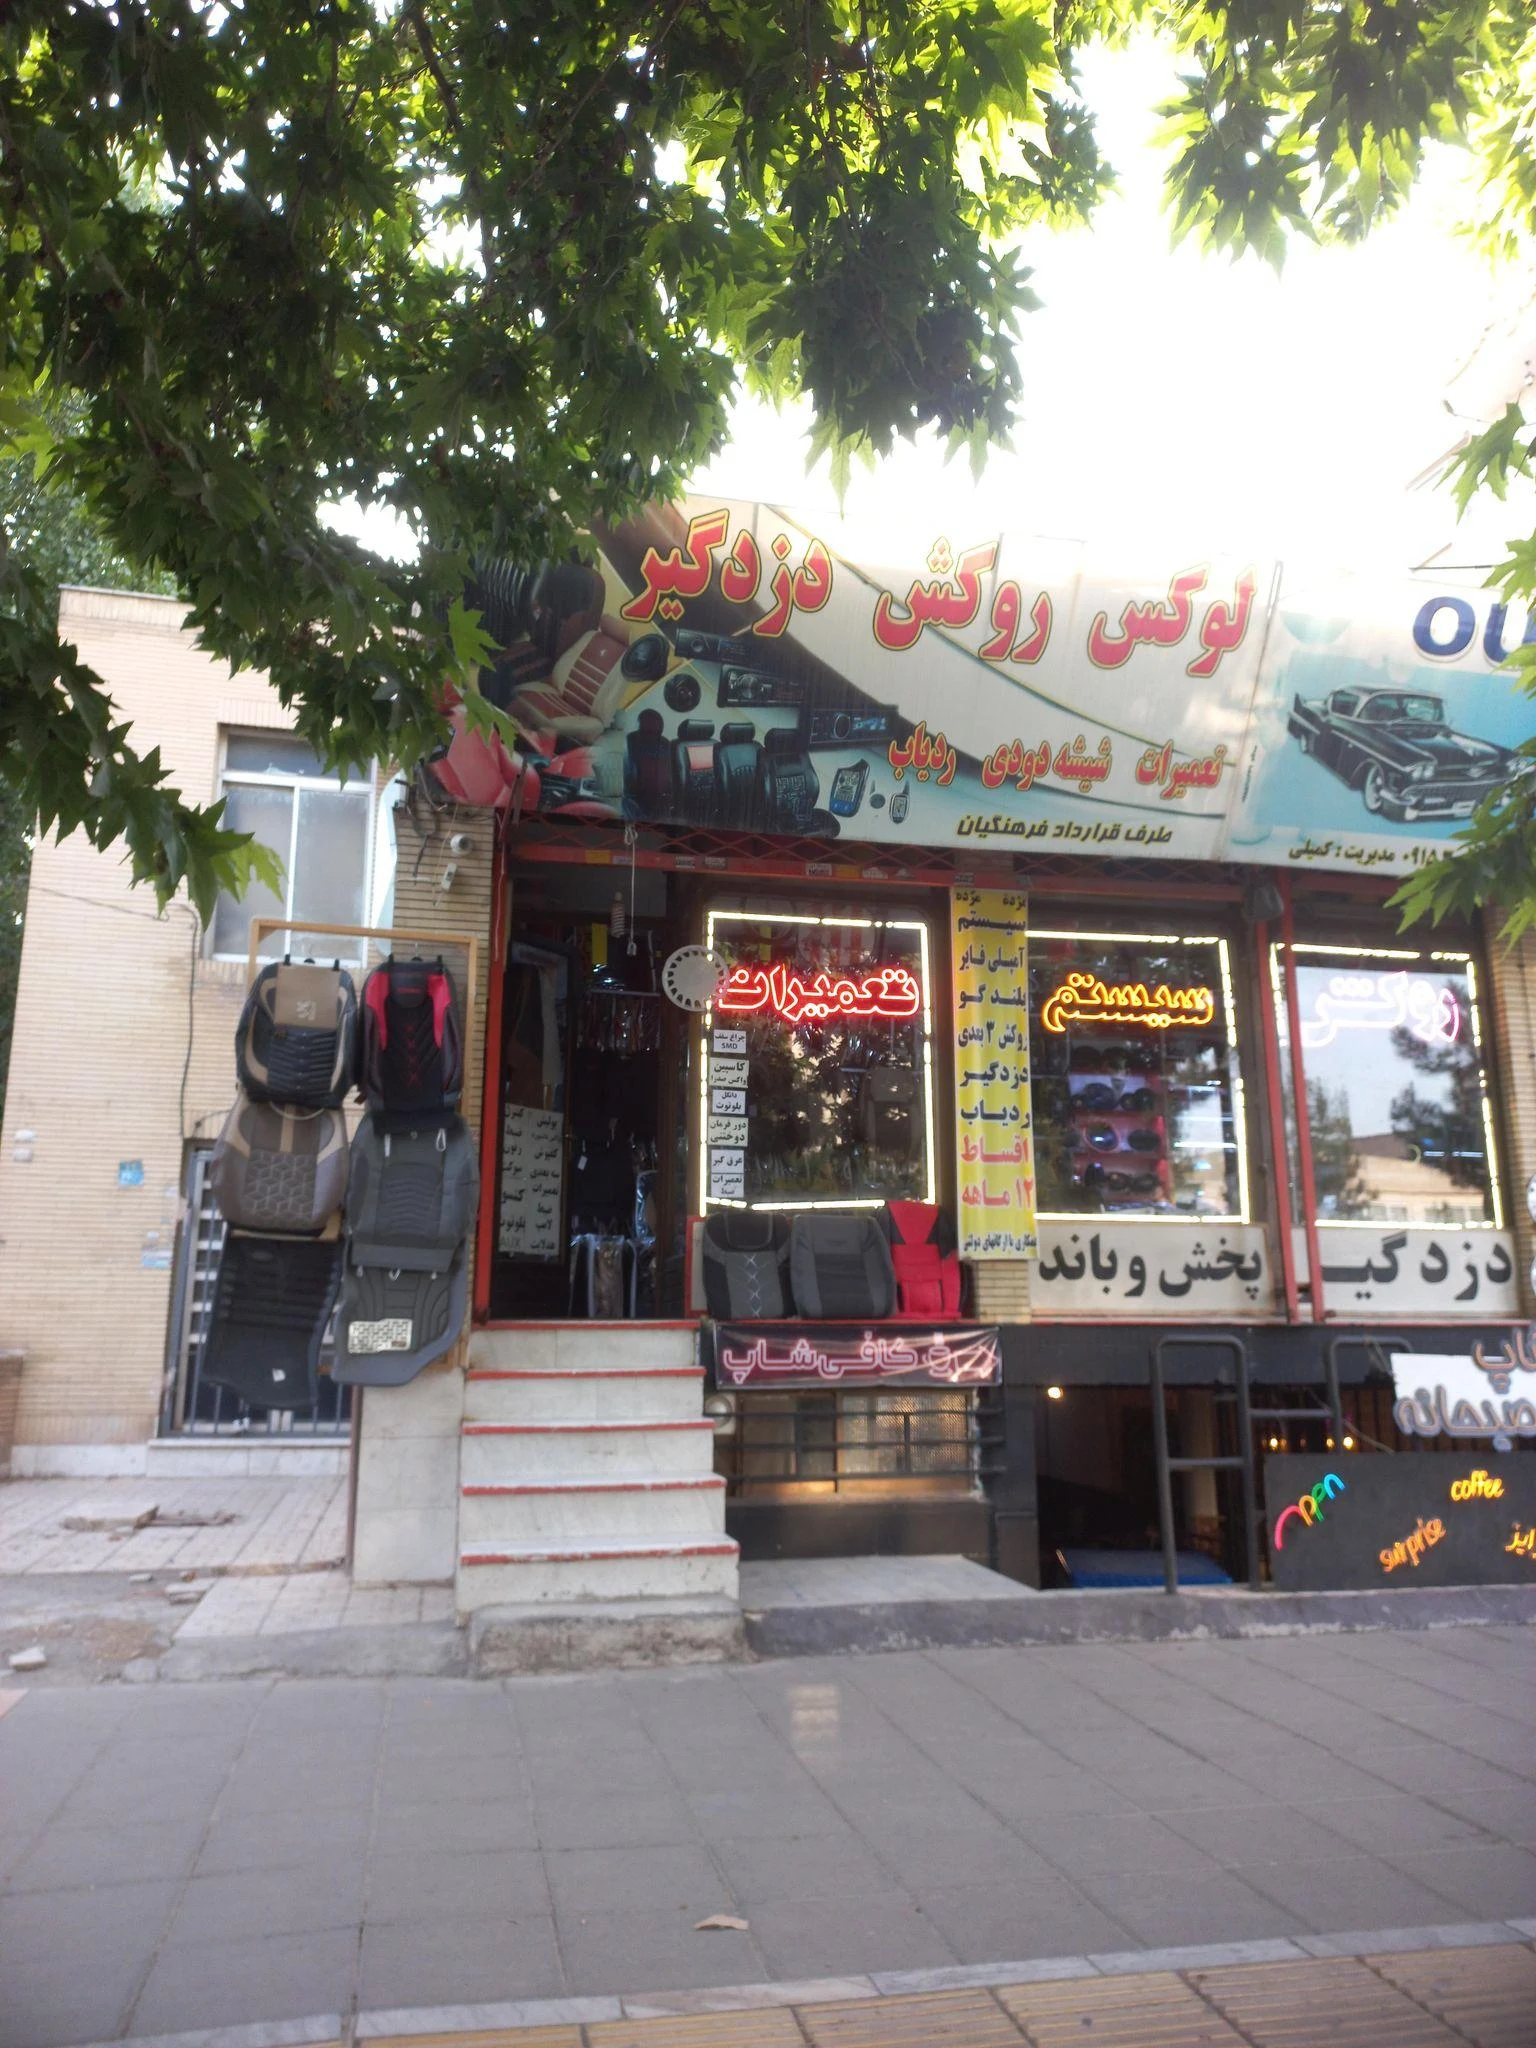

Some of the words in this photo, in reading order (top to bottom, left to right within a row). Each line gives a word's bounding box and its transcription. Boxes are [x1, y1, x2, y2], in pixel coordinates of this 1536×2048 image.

[620, 508, 833, 638] دزدگیر
[873, 536, 1053, 664] روکش
[1088, 563, 1257, 678] لوکس
[888, 722, 956, 785] ردیاب
[982, 737, 1050, 790] دودی
[1053, 735, 1112, 792] شیشه
[1136, 740, 1228, 800] تعمیرات
[957, 813, 1048, 839] فرهنگیان
[1052, 822, 1121, 842] قرارداد
[1124, 826, 1173, 843] طرف
[958, 910, 1026, 935] سیستم
[959, 944, 985, 970] فایر
[718, 962, 920, 1022] تعمیرات
[1041, 971, 1214, 1033] سیستم
[958, 1024, 984, 1048] بعدی
[998, 1023, 1027, 1052] روکش
[960, 1099, 1031, 1128] ردیاب
[961, 1134, 1029, 1163] اقساط
[712, 1175, 743, 1185] تعمیرات
[962, 1178, 1010, 1207] ماهه
[1038, 1233, 1119, 1294] باند
[1159, 1235, 1263, 1299] پخش
[1450, 1469, 1504, 1501] coffee
